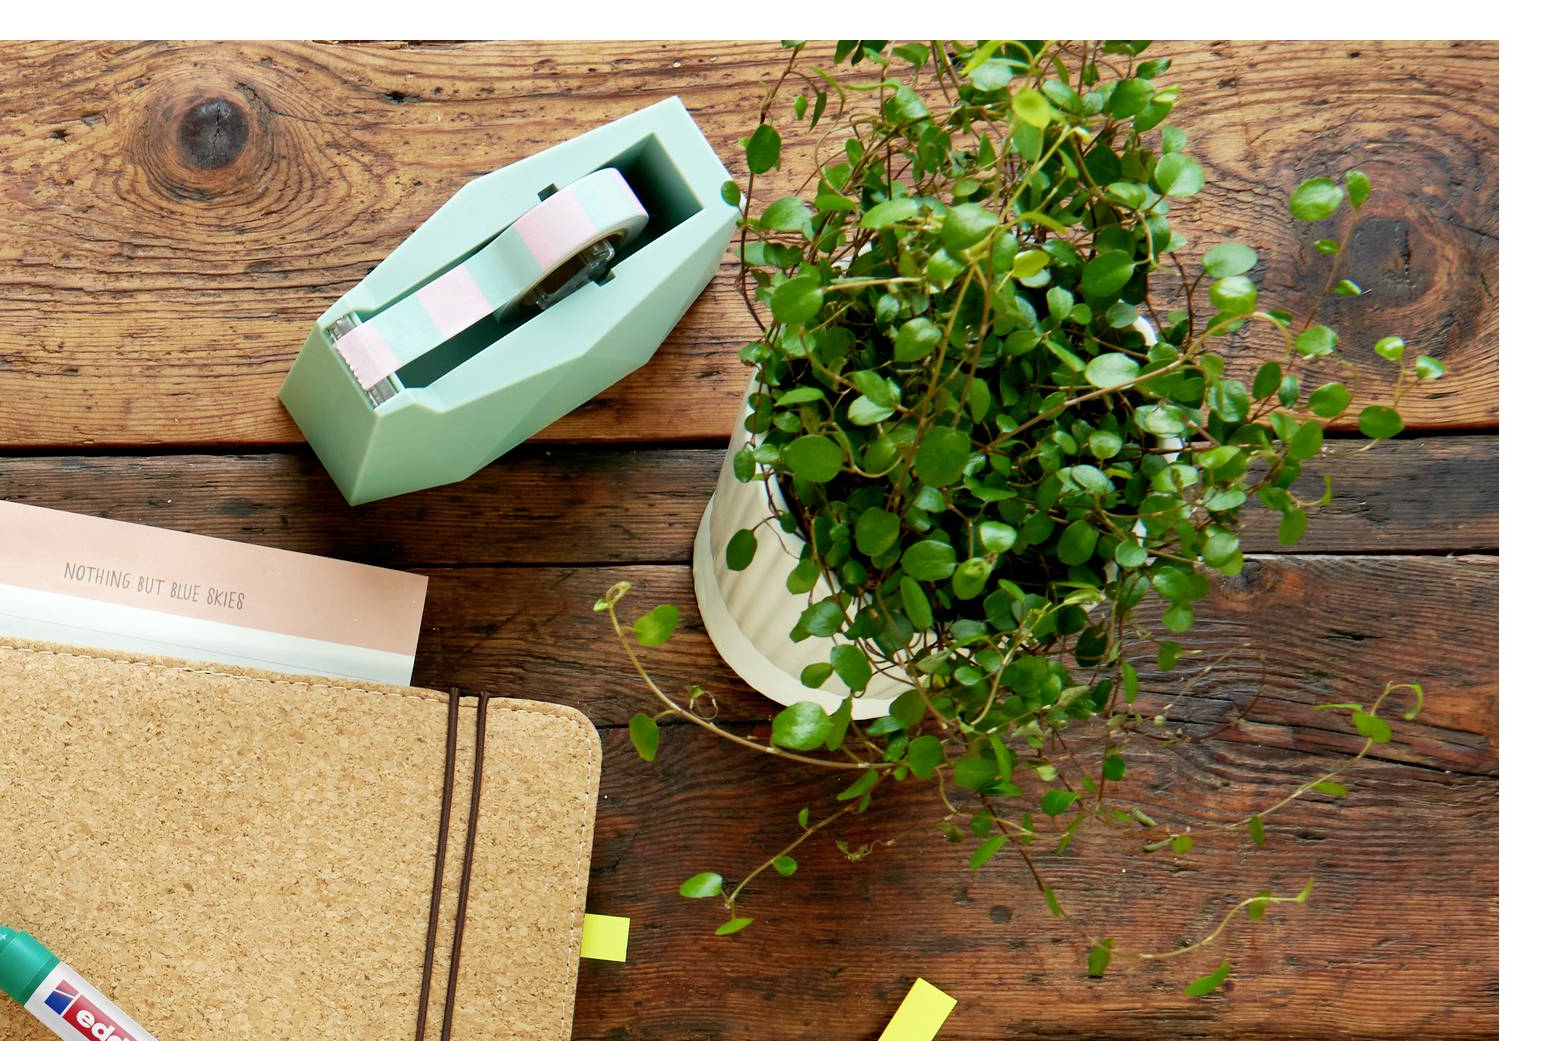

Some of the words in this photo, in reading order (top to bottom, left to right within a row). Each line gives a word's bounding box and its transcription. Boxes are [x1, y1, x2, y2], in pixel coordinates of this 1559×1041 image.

[63, 560, 132, 589] NOTHING
[136, 575, 166, 596] BUT
[170, 581, 201, 603] BLUE
[206, 587, 246, 610] SKIES
